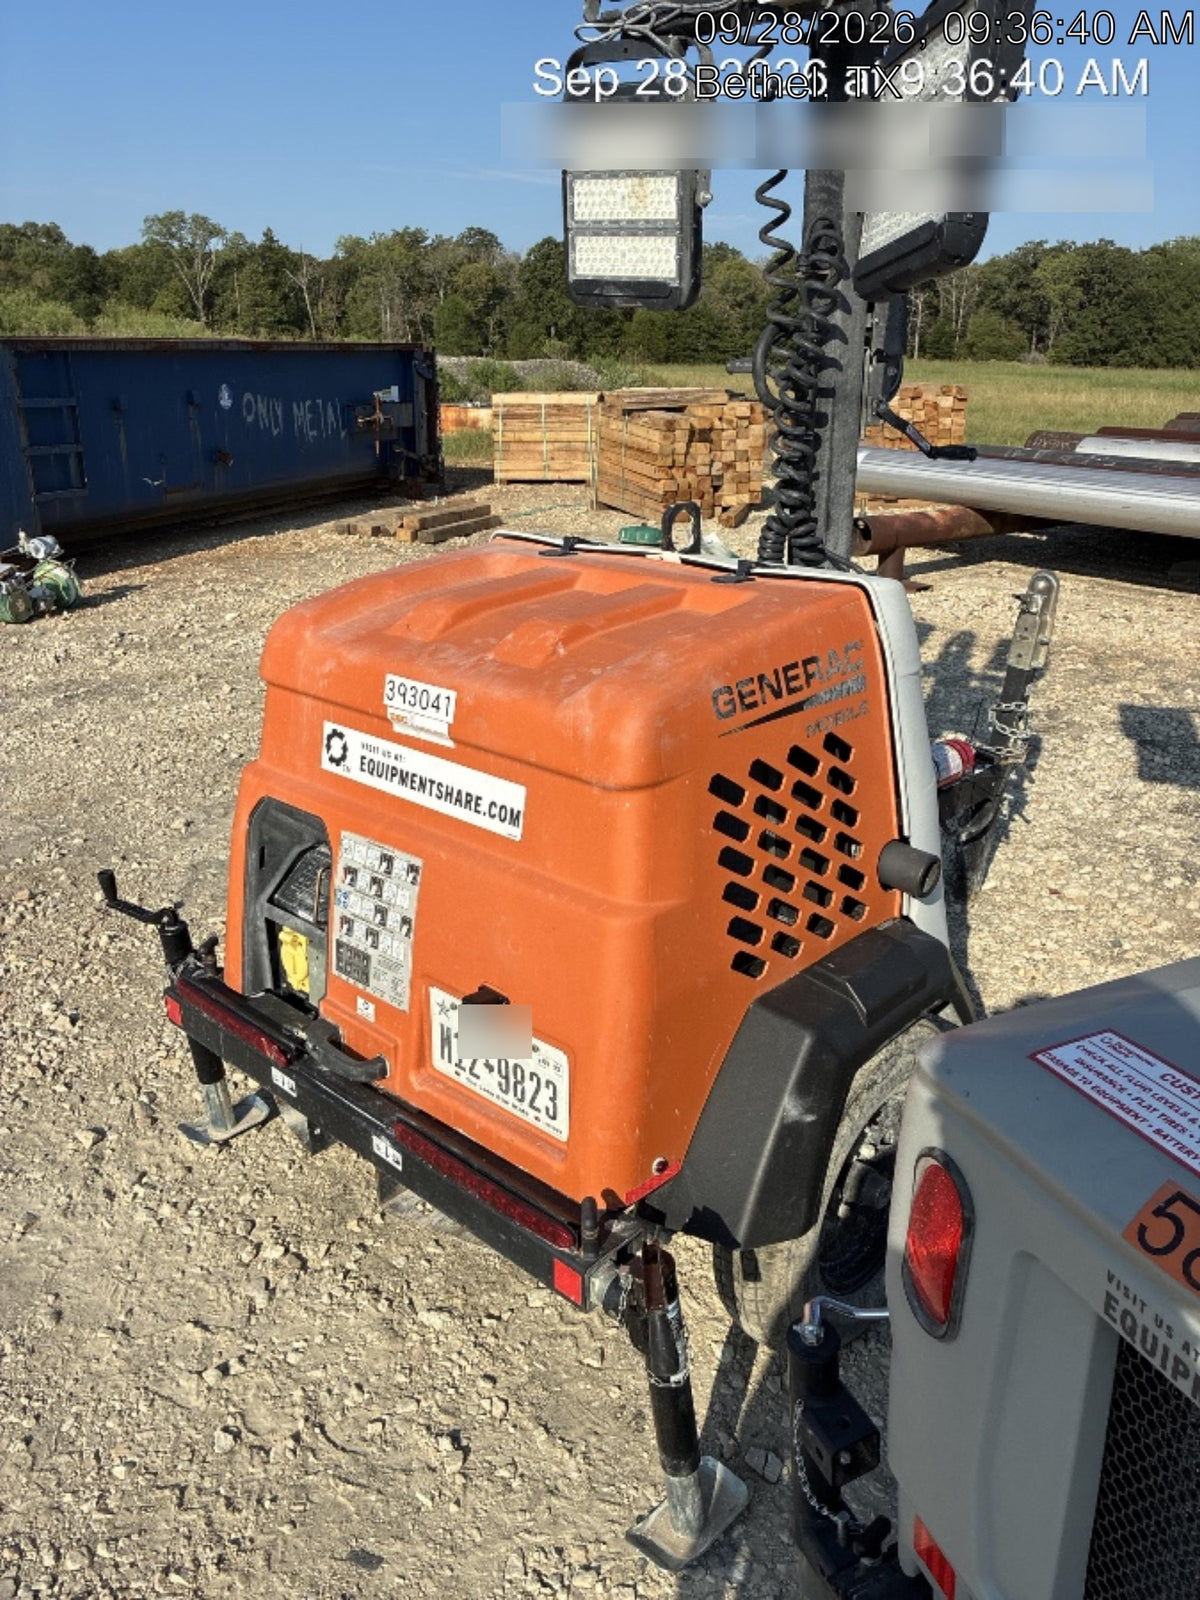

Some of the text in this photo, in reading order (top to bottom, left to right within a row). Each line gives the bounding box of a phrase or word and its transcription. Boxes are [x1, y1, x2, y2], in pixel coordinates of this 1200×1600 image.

[242, 392, 347, 443] ONLY METAL
[386, 679, 451, 717] 393041
[711, 640, 865, 720] GENERAC
[359, 754, 522, 829] EQUIPMENTSHARE.COM
[1041, 1050, 1081, 1078] DAMAGE
[1078, 1074, 1093, 1086] TO
[1090, 1084, 1150, 1123] EQUIPMENT
[1075, 1044, 1105, 1064] CHECK
[1104, 1063, 1125, 1077] ALL
[1122, 1073, 1153, 1094] FLUID
[1150, 1092, 1191, 1118] LEVELS
[1107, 1268, 1149, 1314] VISIT
[1153, 1312, 1175, 1340] US
